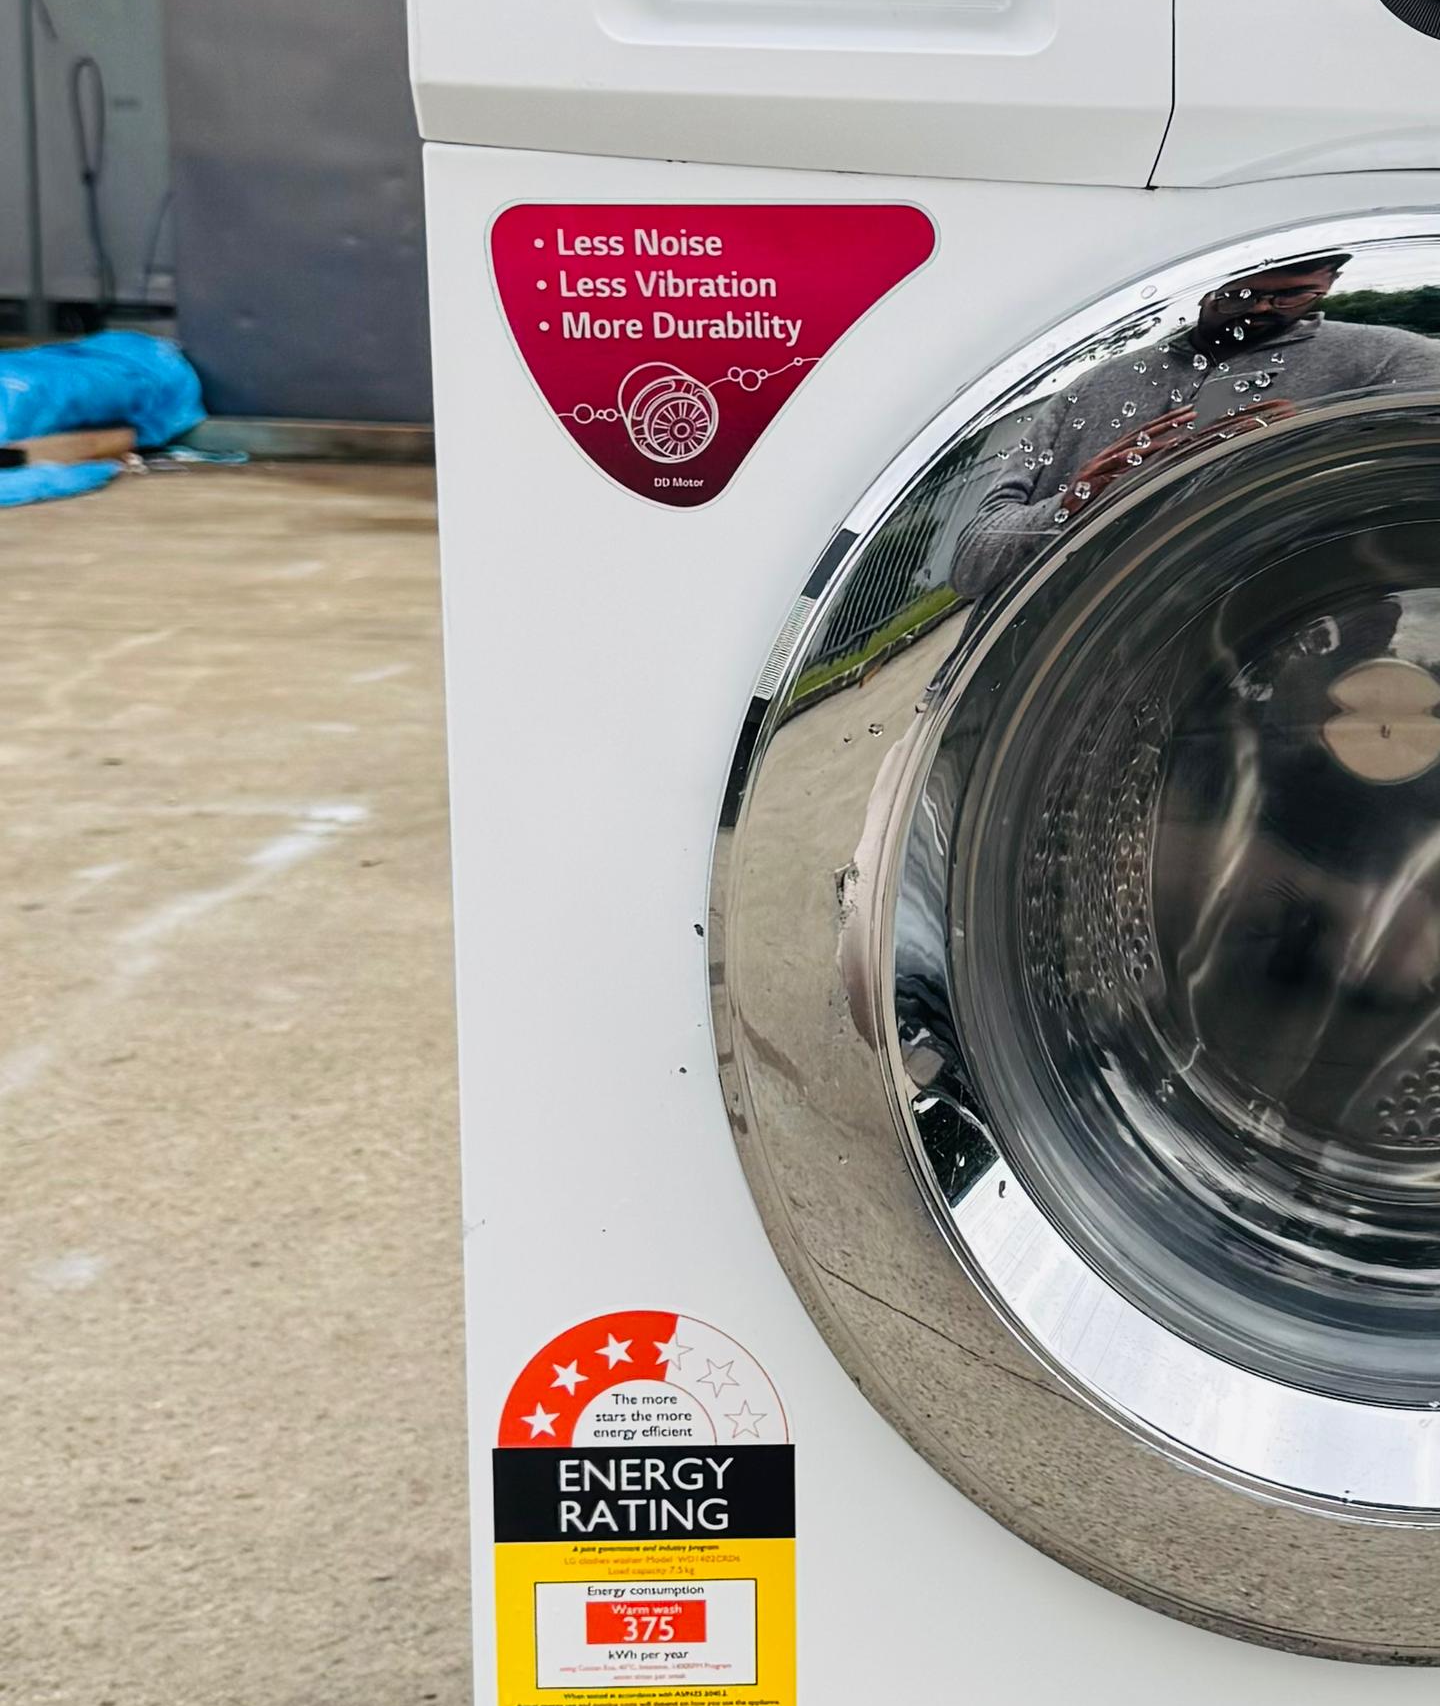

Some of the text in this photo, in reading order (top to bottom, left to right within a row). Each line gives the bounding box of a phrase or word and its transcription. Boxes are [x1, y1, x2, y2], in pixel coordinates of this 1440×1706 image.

[556, 229, 722, 256] Less Noise
[559, 271, 777, 297] Less Vibration
[562, 312, 802, 347] More Durability
[654, 477, 704, 487] DD Motor
[611, 1393, 677, 1405] The more
[595, 1411, 692, 1422] stars the more
[593, 1427, 692, 1441] energy efficient
[559, 1457, 734, 1492] ENERGY
[560, 1498, 729, 1532] RATING
[587, 1585, 704, 1599] Energy consumption
[611, 1604, 682, 1615] Warm wash
[623, 1616, 675, 1642] 375
[608, 1649, 688, 1662] kWh per year
